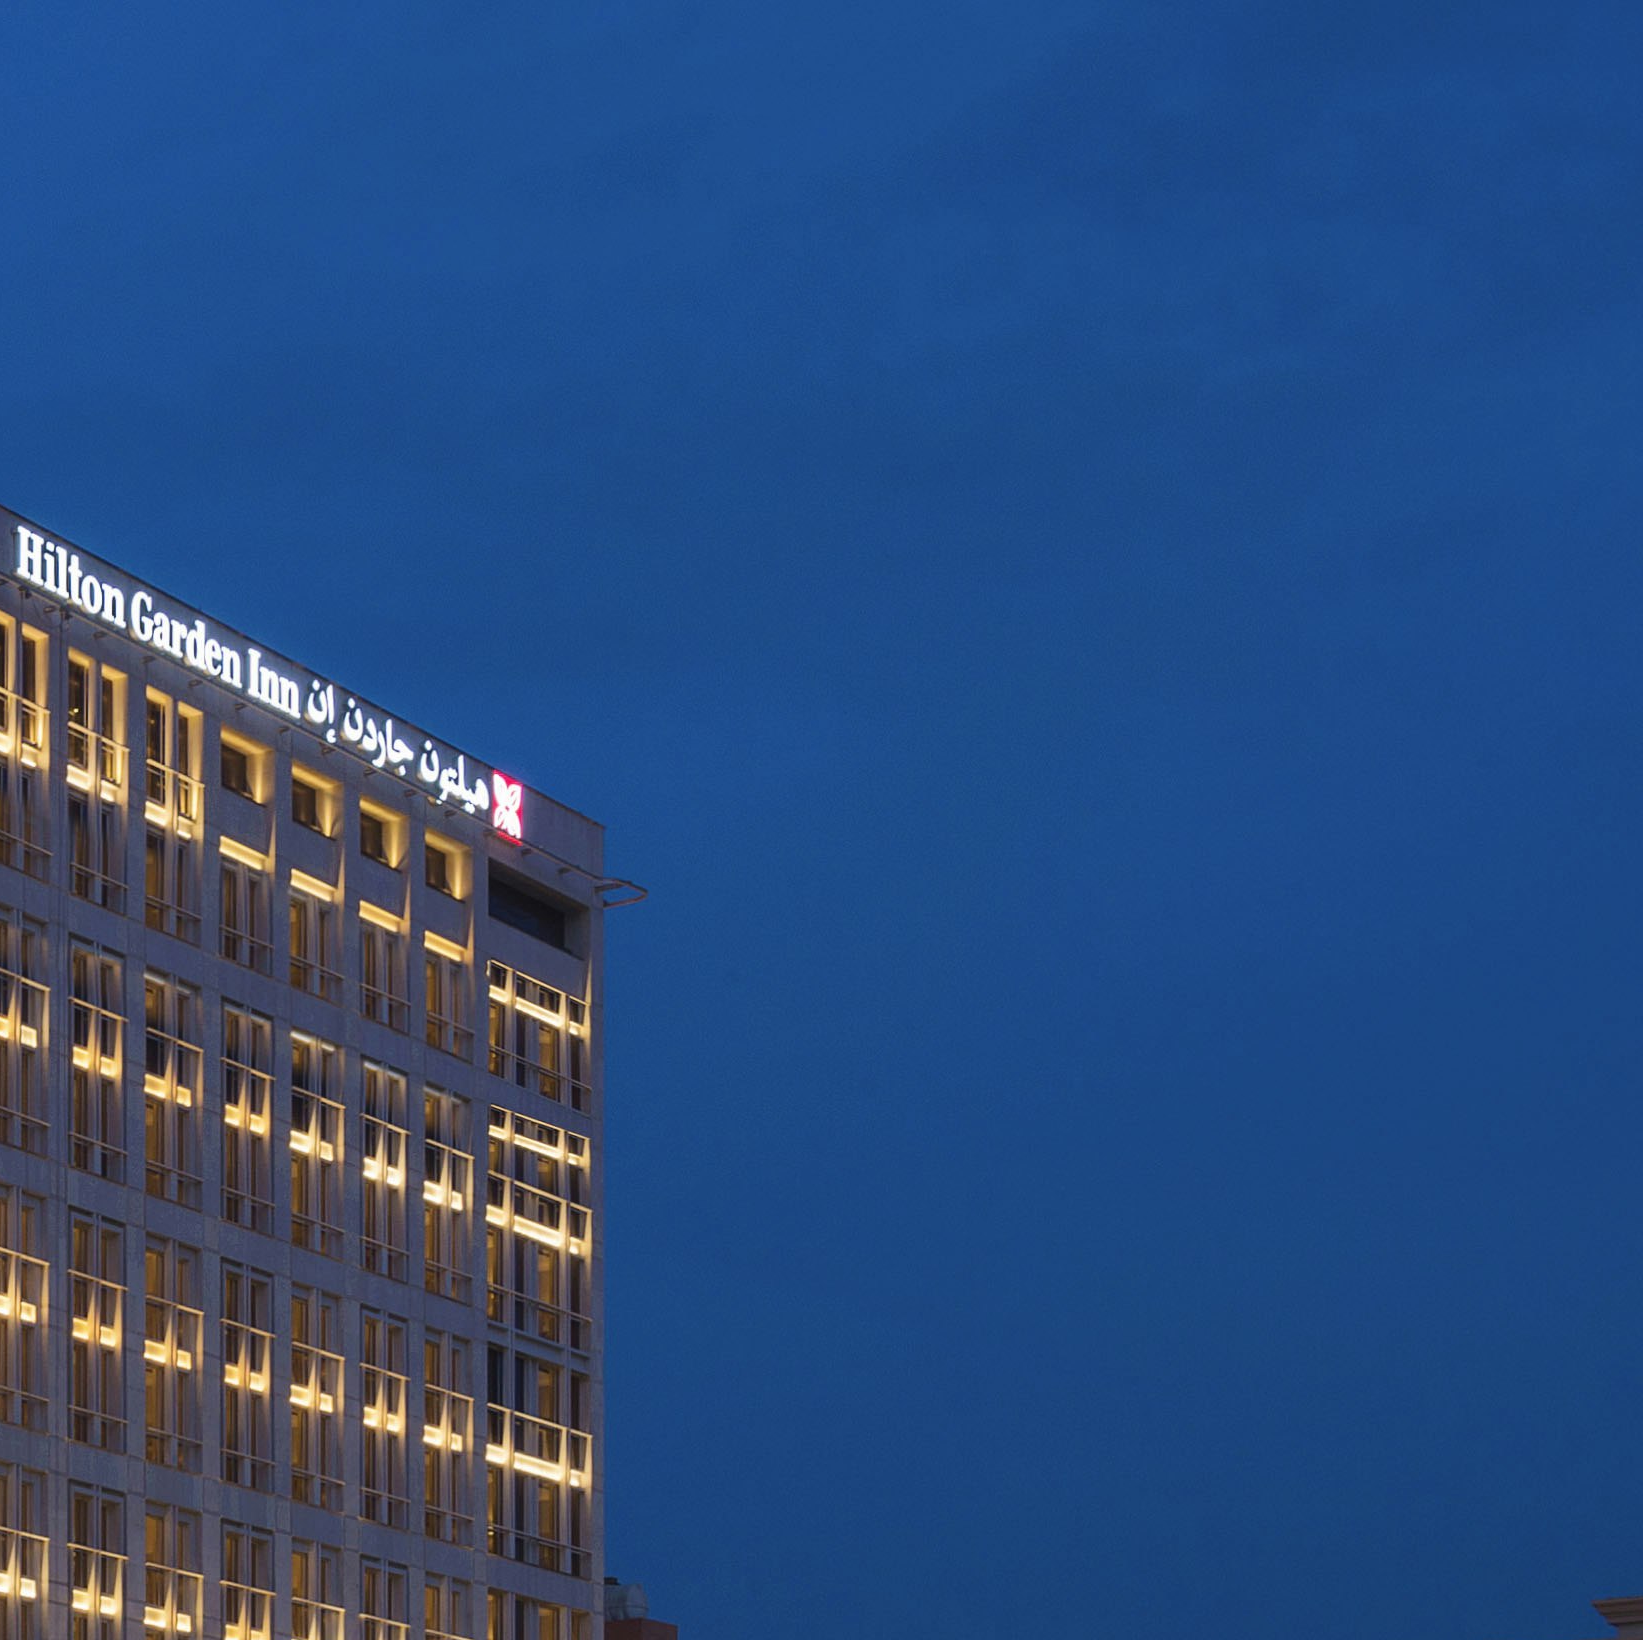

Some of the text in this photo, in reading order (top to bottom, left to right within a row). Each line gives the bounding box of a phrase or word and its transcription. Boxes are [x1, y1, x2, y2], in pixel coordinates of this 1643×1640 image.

[17, 525, 302, 719] Hilton Garden Inn
[307, 679, 490, 814] هيلتون جاردن إن
